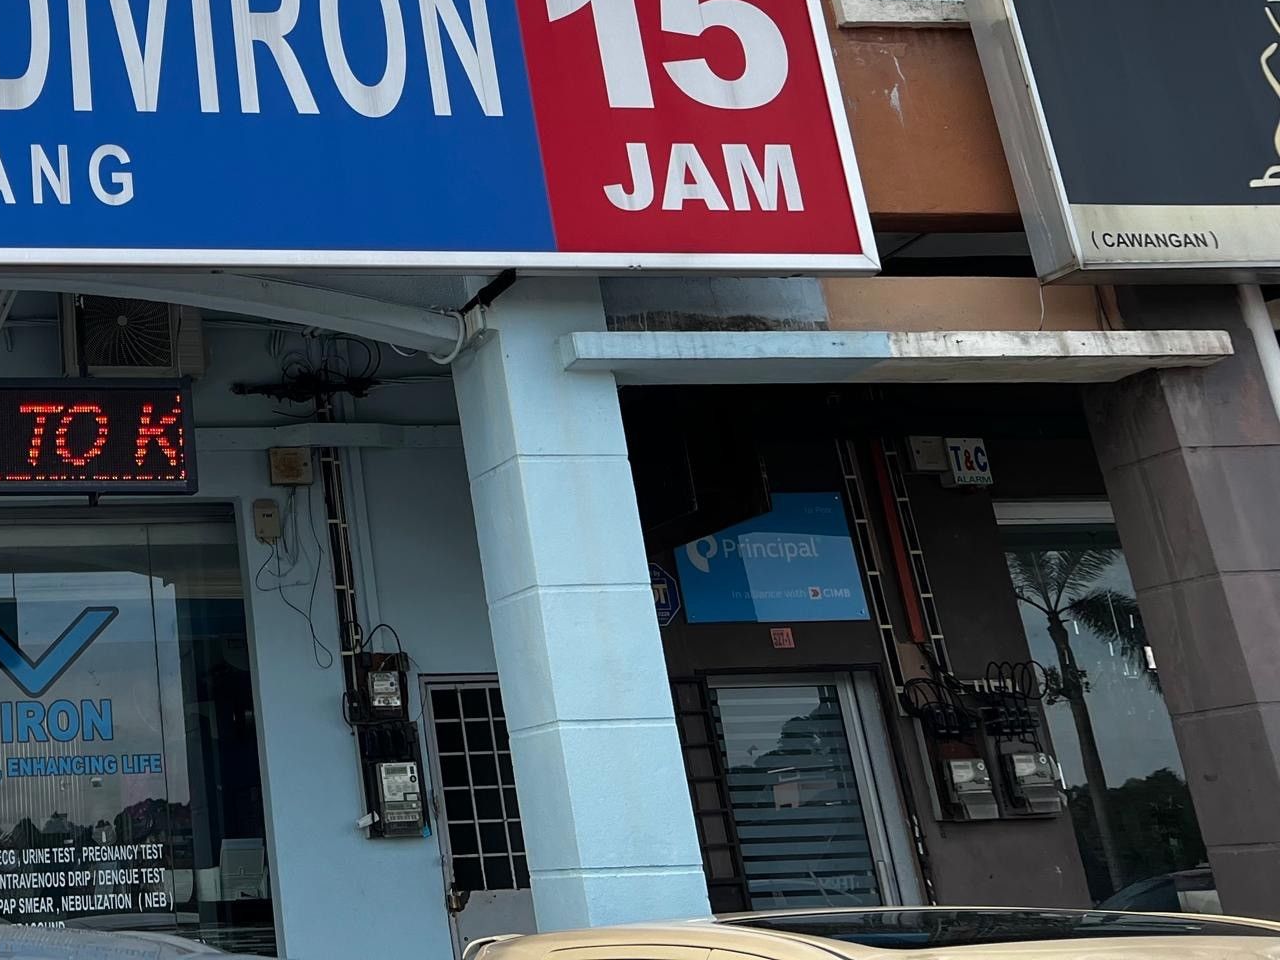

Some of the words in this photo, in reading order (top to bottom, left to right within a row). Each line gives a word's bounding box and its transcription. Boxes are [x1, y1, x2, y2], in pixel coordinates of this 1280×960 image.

[602, 142, 805, 212] JAM
[19, 403, 109, 467] TO
[133, 402, 180, 467] K
[949, 446, 989, 473] T&C
[957, 475, 993, 483] ALARM
[722, 537, 819, 563] Principal
[822, 587, 851, 599] CIMB
[6, 754, 118, 778] ENHANCING
[121, 753, 163, 775] LIFE
[22, 848, 51, 865] URINE
[52, 847, 76, 864] TEST
[82, 844, 139, 863] PREGNANCY
[140, 843, 164, 861] TEST
[68, 870, 91, 887] DRIP
[98, 868, 140, 886] DENGUE
[141, 867, 166, 884] TEST
[18, 896, 54, 914] SMEAR
[61, 893, 132, 913] NEBULIZATION
